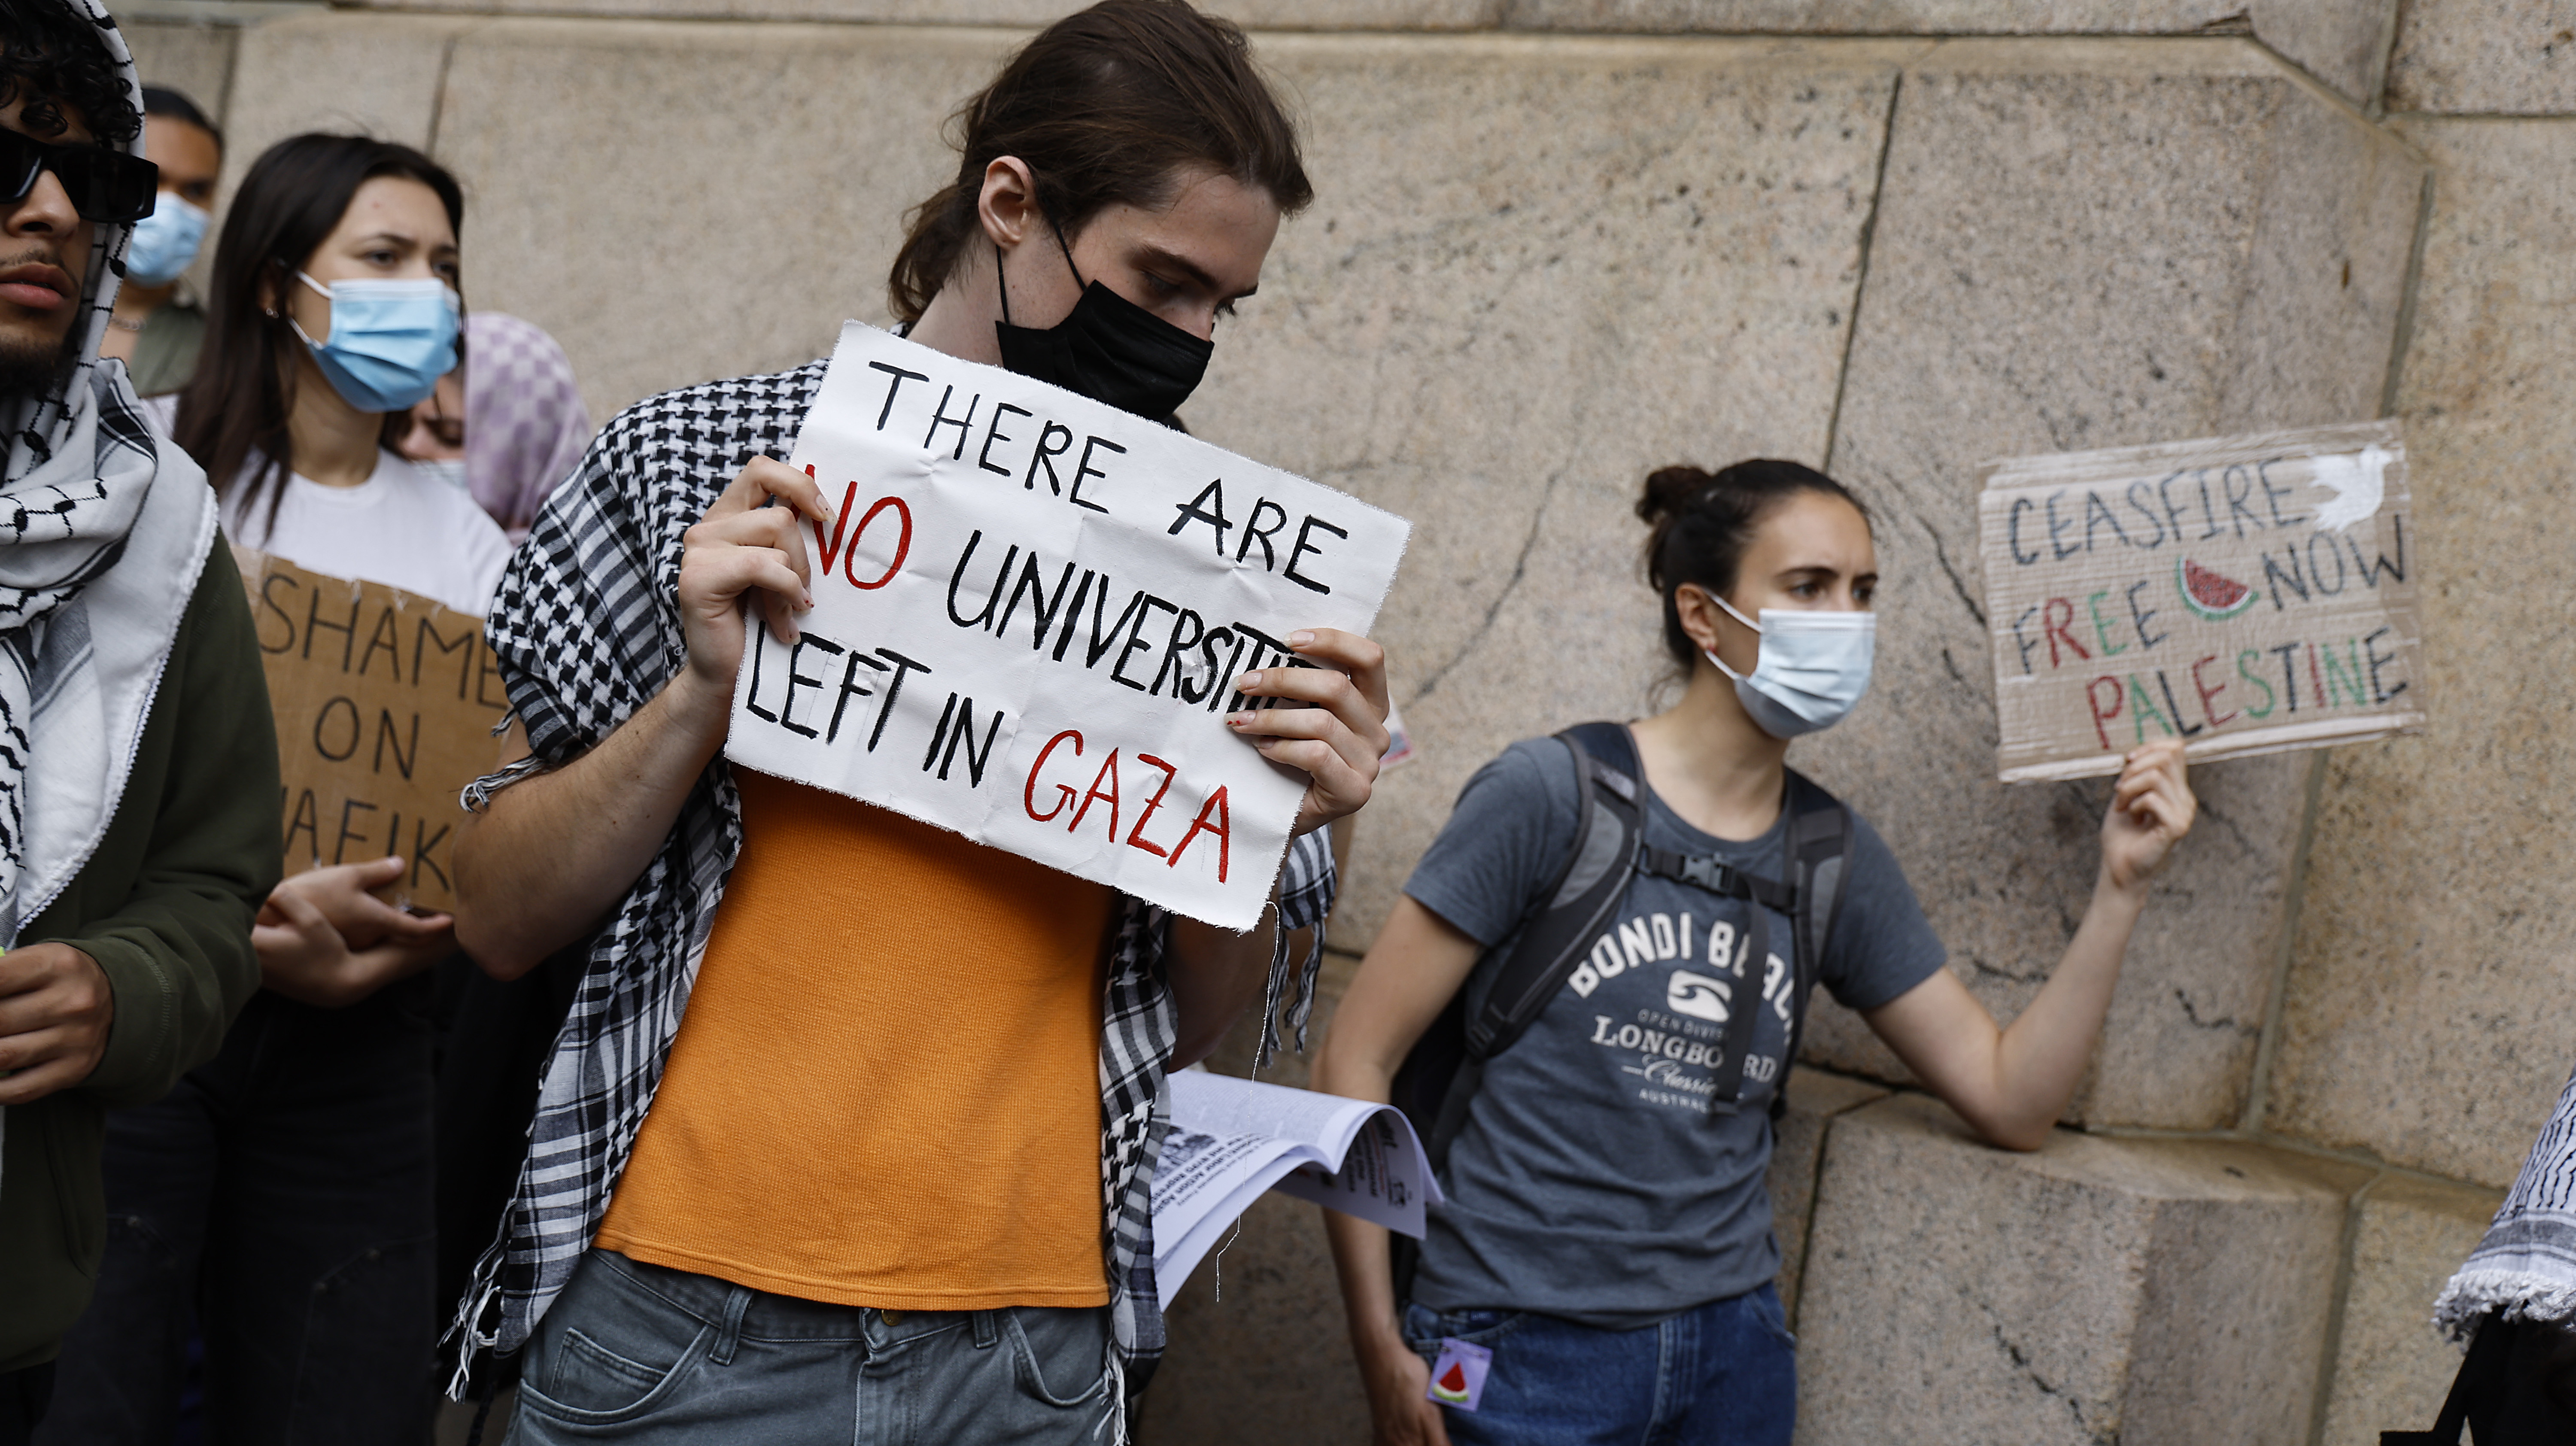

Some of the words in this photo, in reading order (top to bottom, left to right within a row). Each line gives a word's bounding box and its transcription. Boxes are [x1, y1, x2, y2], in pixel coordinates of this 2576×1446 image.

[790, 464, 912, 590] NO
[869, 361, 1127, 514] THERE
[1167, 479, 1348, 595] ARE
[2008, 457, 2309, 565] CEASFIRE
[2262, 515, 2405, 611] NOW
[259, 573, 507, 711] SHAME
[2013, 581, 2168, 675] FREE
[314, 696, 420, 782] ON
[2087, 627, 2407, 750] PALESTINE
[747, 620, 932, 753] LEFT
[923, 692, 1005, 789] IN
[1025, 731, 1230, 884] GAZA
[281, 785, 450, 893] AFIK
[1568, 911, 1692, 999] BONDI
[1590, 1014, 1777, 1083] LONGBORD
[1637, 1009, 1681, 1031] OPEN
[1683, 1019, 1725, 1042] DIVIS
[1638, 1088, 1708, 1114] AUSTRAL
